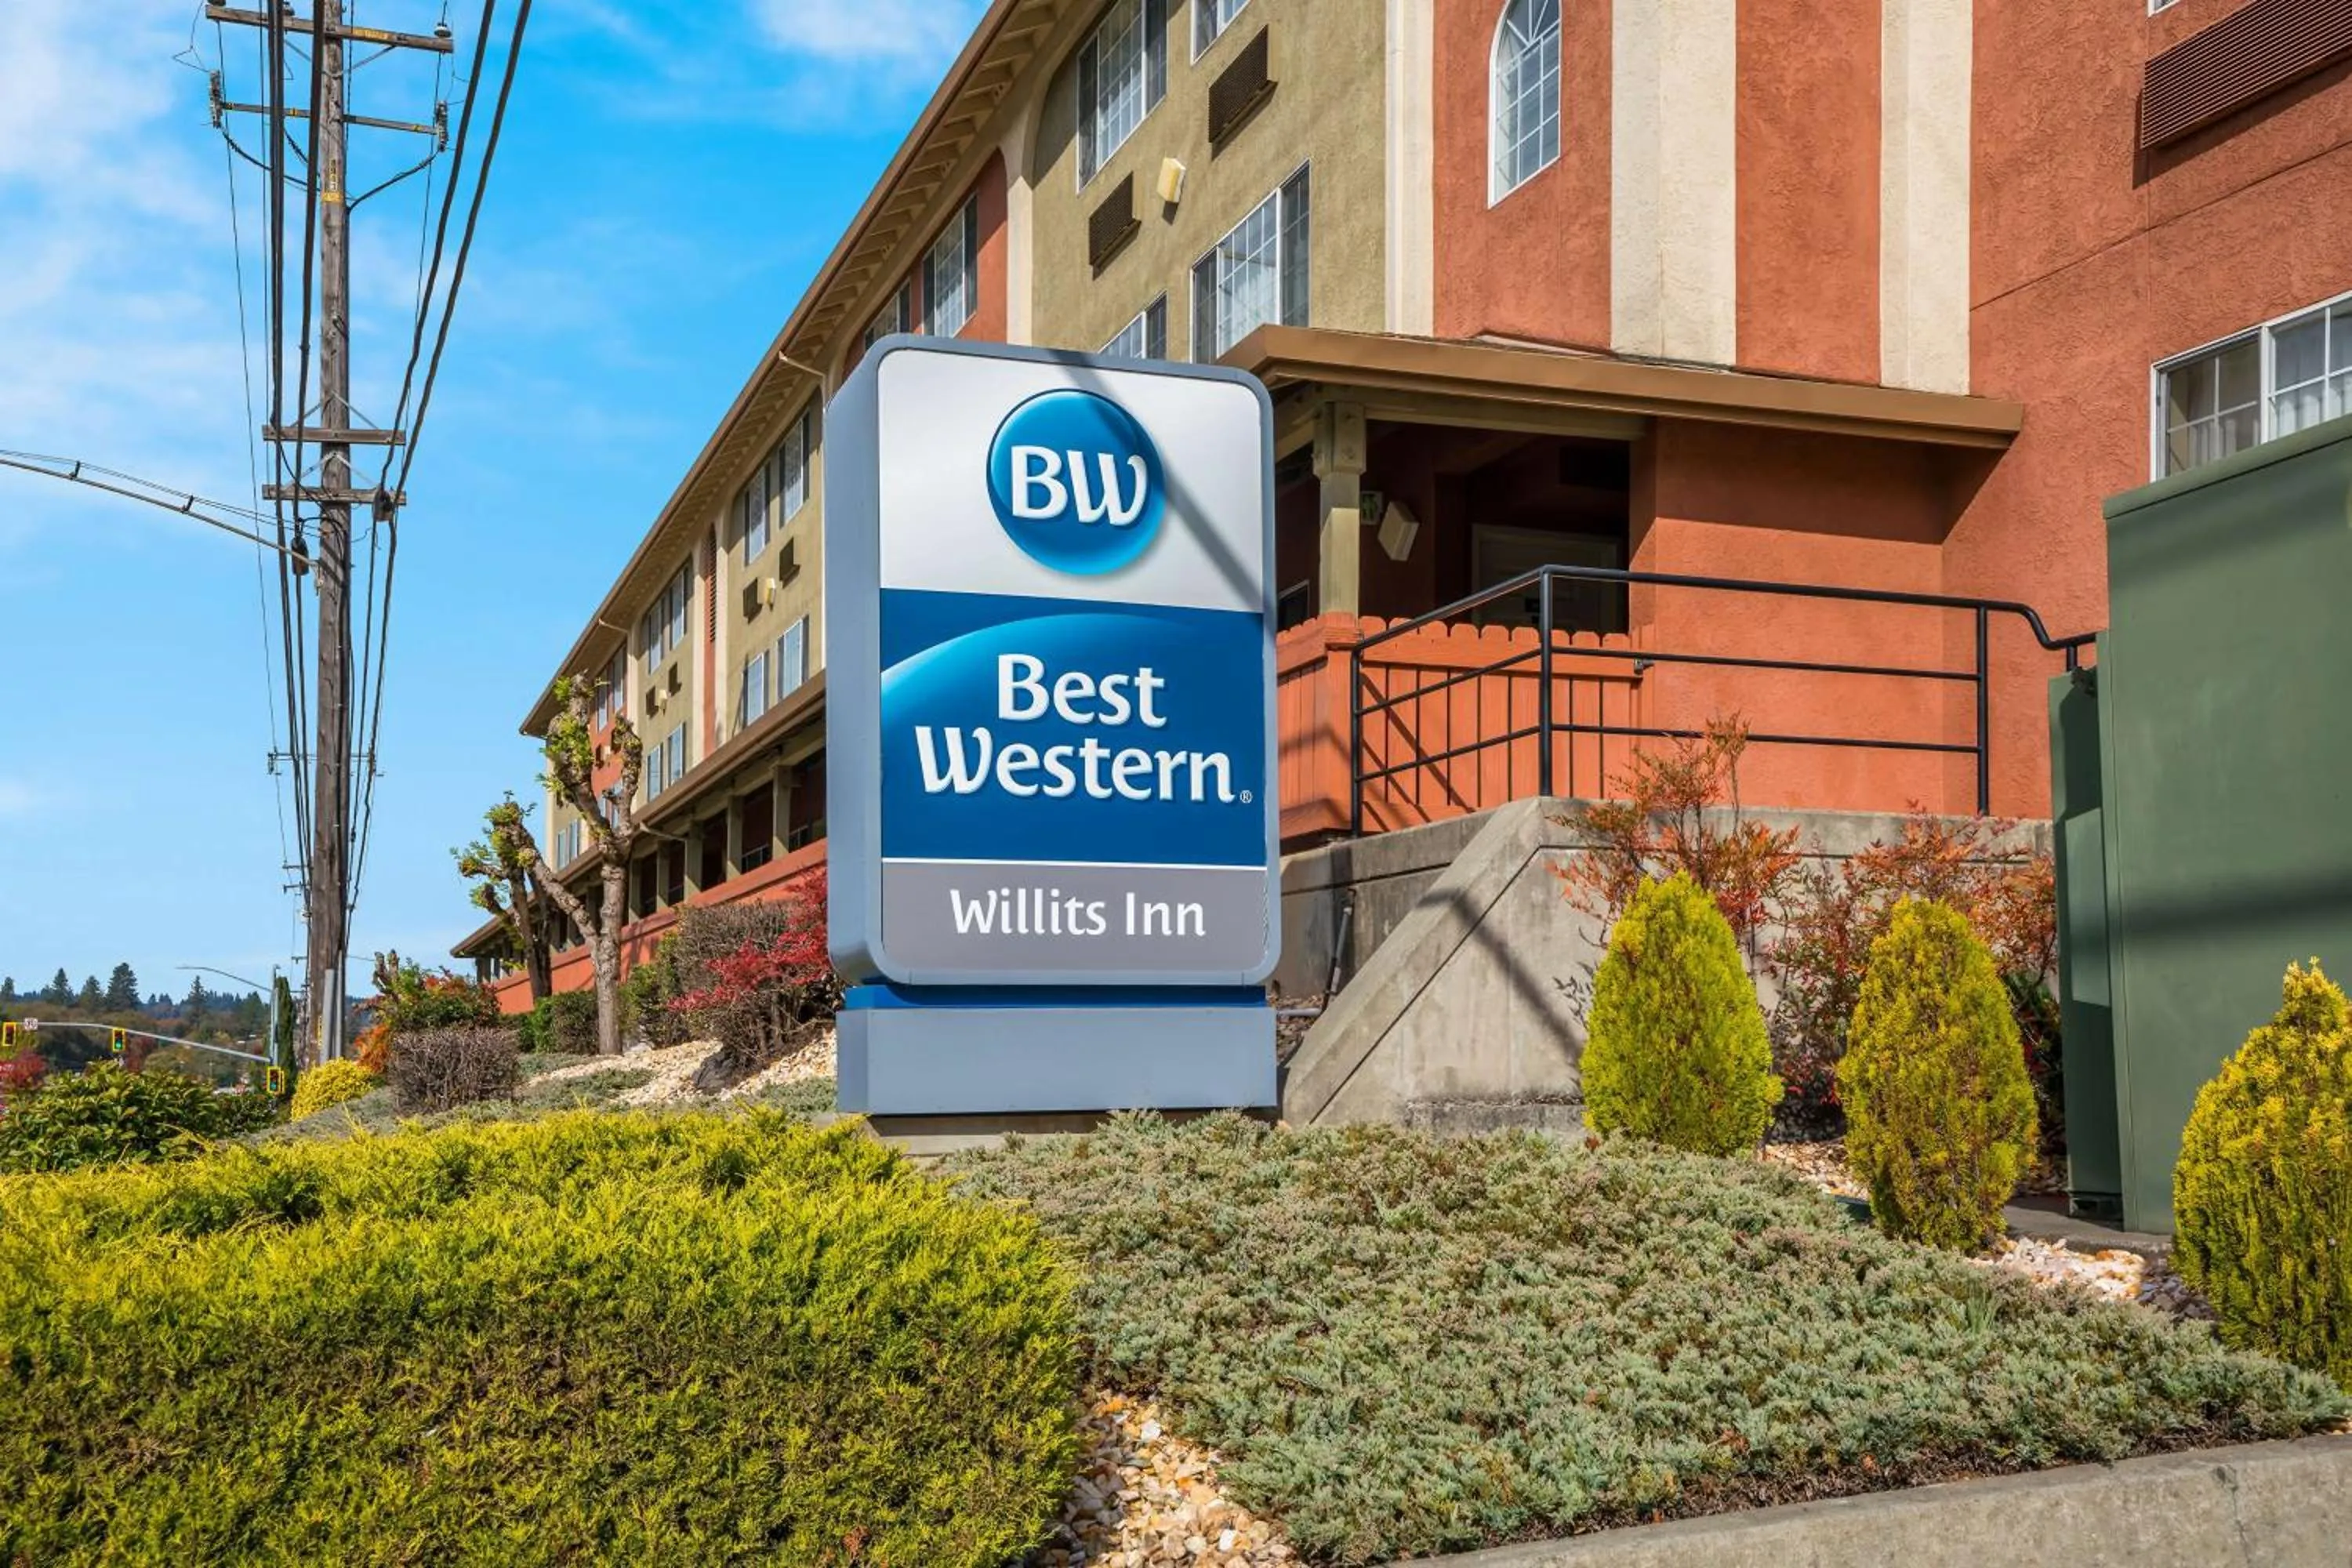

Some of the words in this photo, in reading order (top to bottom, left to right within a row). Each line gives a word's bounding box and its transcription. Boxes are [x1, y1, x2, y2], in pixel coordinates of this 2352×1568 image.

[1011, 445, 1148, 526] BW
[998, 653, 1167, 728] Best
[915, 726, 1236, 803] Western
[949, 887, 1107, 935] Willits
[1126, 892, 1206, 937] Inn
